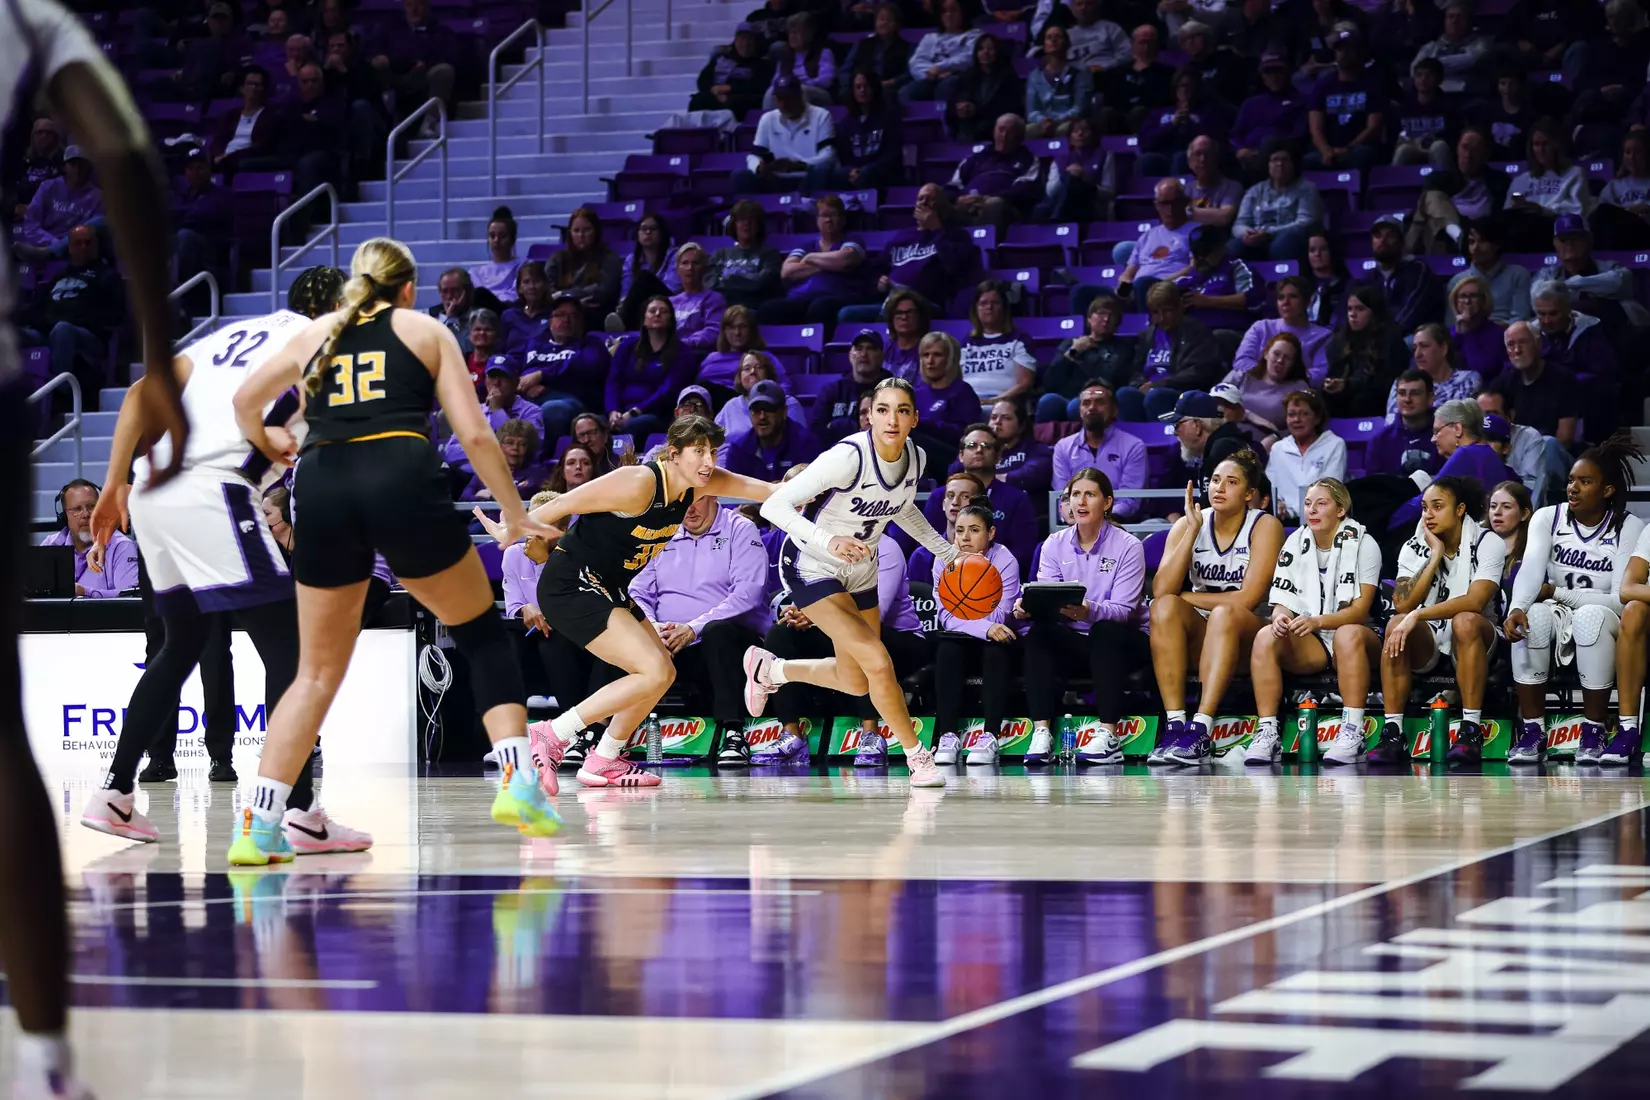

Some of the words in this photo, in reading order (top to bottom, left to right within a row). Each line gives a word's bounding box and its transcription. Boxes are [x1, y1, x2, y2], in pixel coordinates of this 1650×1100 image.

[212, 330, 269, 367] 32
[328, 351, 386, 407] 32
[964, 359, 1005, 374] STATE
[854, 519, 879, 540] 3
[1554, 544, 1613, 572] Wildcats
